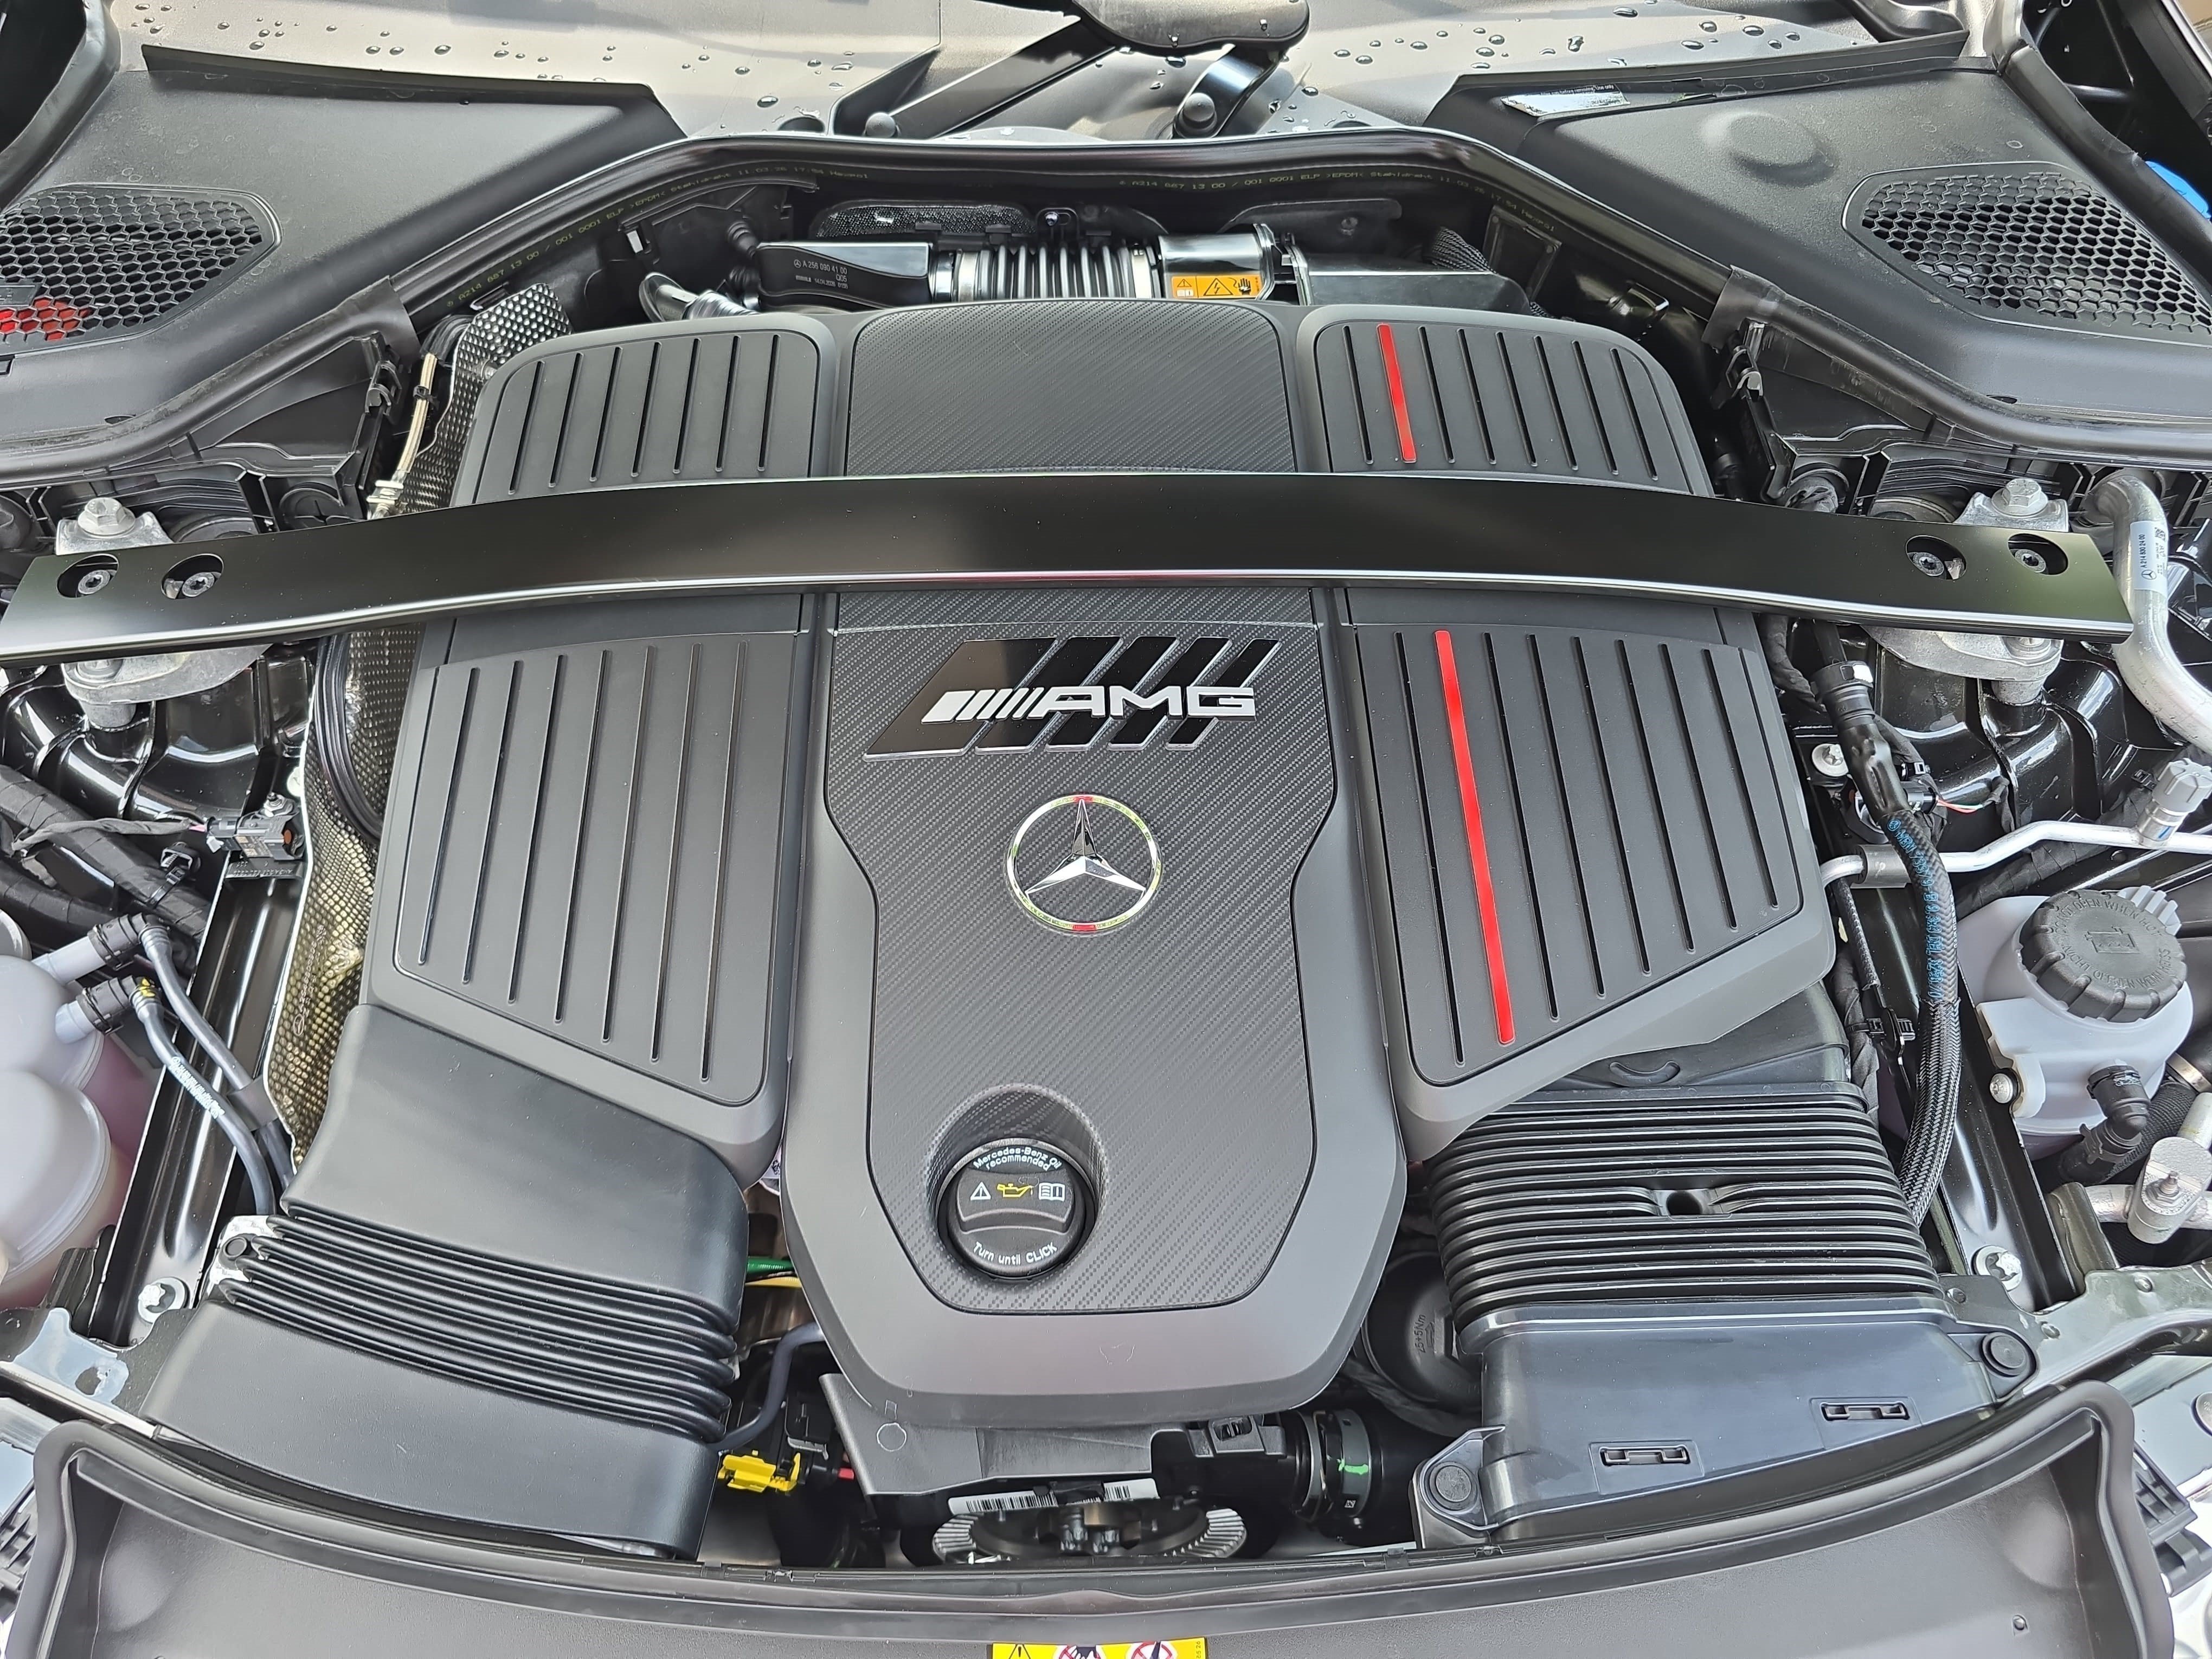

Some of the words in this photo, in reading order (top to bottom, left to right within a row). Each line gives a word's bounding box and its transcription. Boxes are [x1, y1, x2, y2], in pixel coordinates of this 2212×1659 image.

[555, 233, 573, 245] 001
[1027, 685, 1256, 720] AMG
[1894, 829, 1917, 853] MBN
[2073, 899, 2102, 910] OPEN
[2105, 899, 2139, 919] WHEN
[2139, 918, 2163, 936] HOT
[2062, 945, 2091, 972] NICHT
[973, 1147, 1049, 1169] Mercedes-Benz
[1049, 1156, 1063, 1169] Oil
[986, 1154, 1050, 1172] recommended
[973, 1242, 994, 1262] Turn
[998, 1254, 1021, 1266] until
[1026, 1242, 1058, 1263] CLICK
